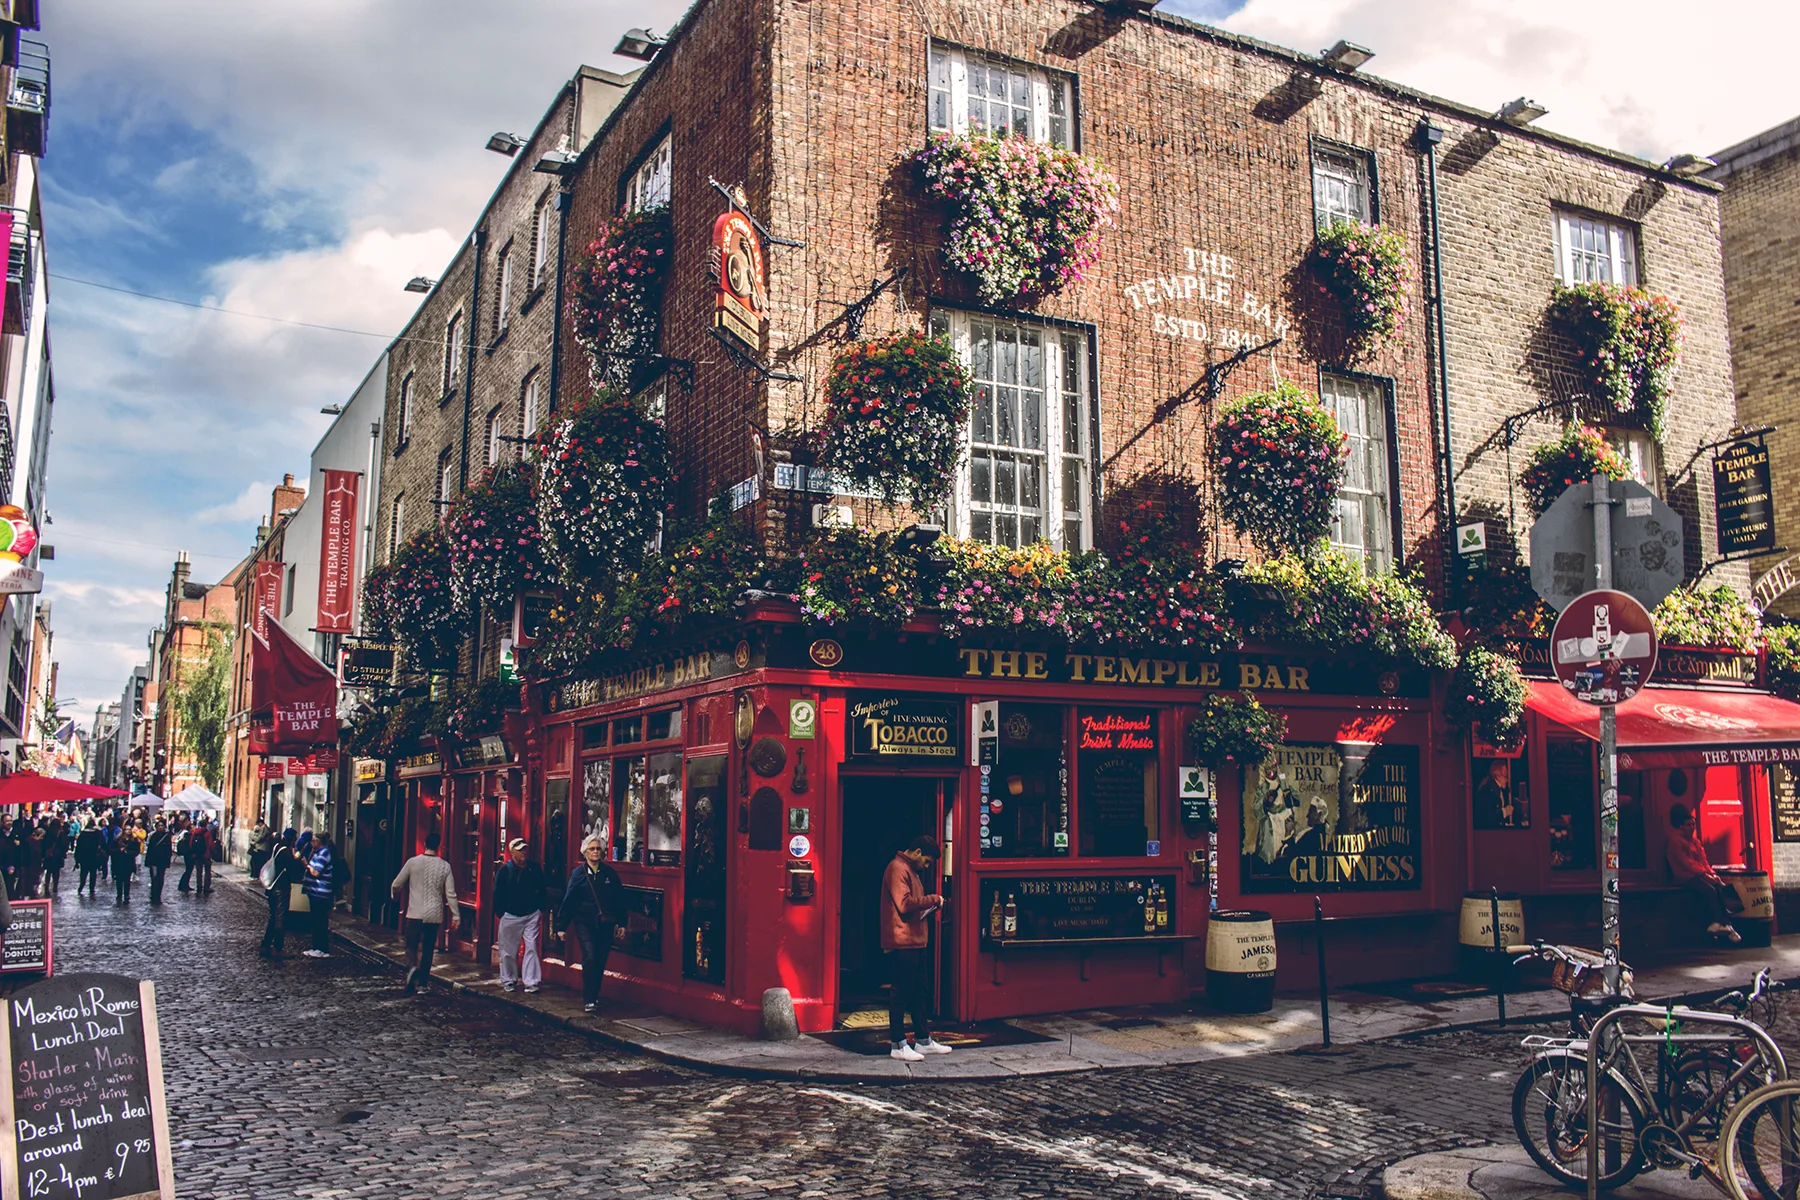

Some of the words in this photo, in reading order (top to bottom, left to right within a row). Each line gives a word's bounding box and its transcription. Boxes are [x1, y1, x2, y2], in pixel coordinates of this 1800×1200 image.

[1183, 246, 1235, 280] THE
[1123, 275, 1233, 311] TEMPLE
[1240, 290, 1292, 341] BAR
[1731, 446, 1749, 457] THE
[1714, 452, 1767, 473] TEMPLE
[1727, 468, 1756, 484] BAR
[1719, 498, 1738, 509] BEER
[1738, 493, 1769, 508] GARDEN
[330, 499, 342, 525] BAR
[342, 518, 351, 535] CO.
[1722, 527, 1741, 538] LIVE
[1741, 521, 1769, 534] MUSIC
[1733, 532, 1758, 545] DAILY
[327, 527, 340, 578] TEMPLE
[340, 537, 350, 589] TRADING
[326, 579, 337, 606] THE
[1756, 561, 1796, 606] THE
[257, 593, 266, 631] TRDING
[815, 644, 836, 660] 48
[604, 663, 666, 699] TEMPLE
[674, 651, 712, 684] BAR
[959, 649, 1049, 680] THE
[1065, 654, 1221, 687] TEMPLE
[1239, 663, 1310, 691] BAR
[276, 707, 332, 722] TEMPLE
[293, 701, 316, 710] THE
[850, 697, 899, 718] Importers
[292, 720, 319, 731] BAR
[893, 714, 912, 723] FINE
[912, 715, 948, 724] SMOKING
[1081, 713, 1151, 732] Traditional
[863, 718, 949, 751] TOBACCO
[1080, 731, 1113, 749] Irish
[1117, 732, 1155, 750] Music
[881, 745, 914, 754] Always
[917, 746, 926, 754] in
[929, 746, 955, 755] Stock
[1274, 750, 1338, 767] TEMPLE
[1702, 750, 1729, 765] THE
[1730, 748, 1780, 763] TEMPLE
[1781, 747, 1800, 761] BA
[1294, 766, 1325, 784] BAR
[1382, 764, 1407, 783] THE
[1352, 784, 1408, 804] EMPEROR
[1393, 807, 1408, 824] OF
[1319, 832, 1366, 854] MALTED
[1289, 854, 1415, 883] GUINNESS
[1020, 880, 1050, 895] THE
[1053, 879, 1110, 895] TEMPLE
[1067, 895, 1097, 904] DUBLIN
[1053, 919, 1068, 927] LIVE
[1480, 923, 1520, 935] JAESON
[4, 949, 42, 958] DONUTS
[13, 997, 79, 1028] Mexico
[78, 994, 91, 1017] to
[86, 987, 139, 1017] Rome
[31, 1022, 85, 1051] Lunch
[85, 1016, 125, 1041] Deal
[19, 1055, 79, 1083] Starter
[95, 1046, 139, 1071] Main
[16, 1086, 38, 1099] with
[43, 1083, 77, 1100] glass
[84, 1076, 98, 1092] of
[106, 1073, 135, 1084] wine
[33, 1102, 48, 1111] or
[60, 1092, 89, 1107] soft
[98, 1088, 129, 1101] drink
[15, 1112, 66, 1142] Best
[70, 1104, 113, 1130] lunch
[121, 1096, 150, 1120] deal
[23, 1134, 84, 1163] around
